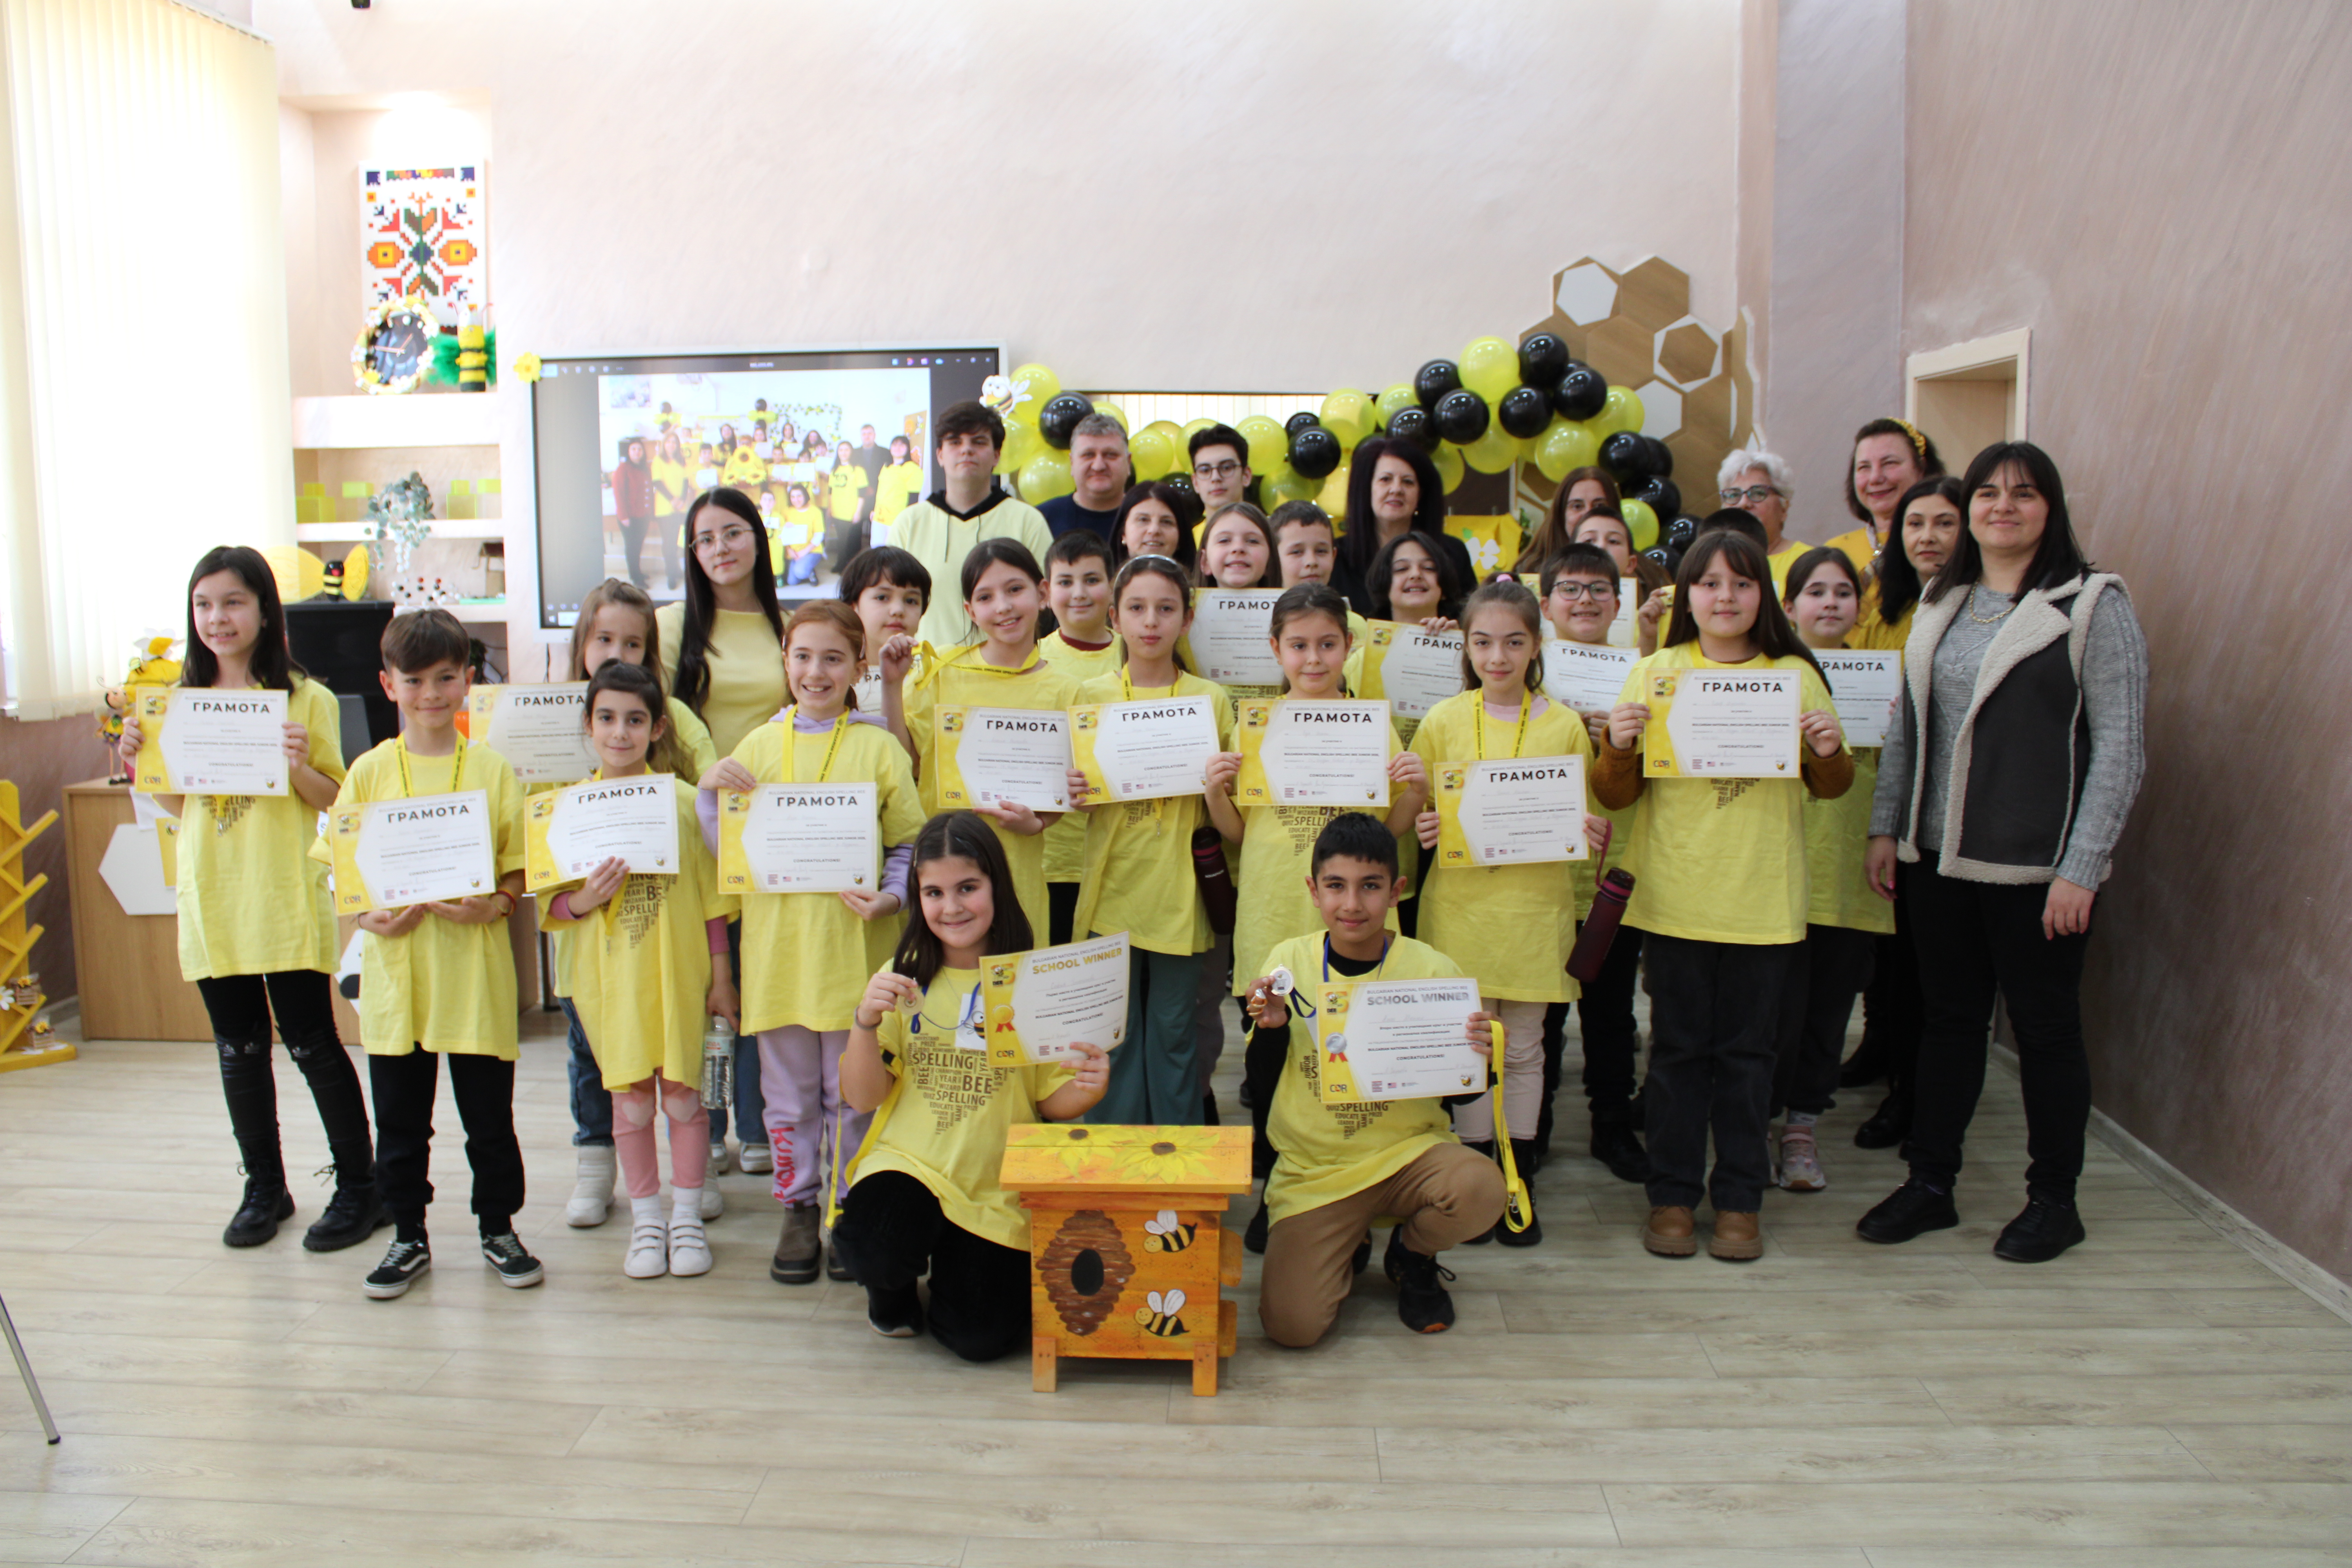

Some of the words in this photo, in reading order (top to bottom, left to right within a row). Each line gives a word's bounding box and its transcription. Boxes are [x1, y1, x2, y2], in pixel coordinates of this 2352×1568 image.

[1562, 648, 1627, 663] ГРАМОТА
[1819, 662, 1885, 671] РАМОТА
[1702, 682, 1783, 692] ГРАМОТА
[515, 695, 585, 706] ГРАМОТА
[193, 702, 270, 713] ГРАМОТА
[1122, 707, 1197, 722] ГРАМОТА
[1294, 713, 1372, 722] ГРАМОТА
[987, 720, 1058, 733] ГРАМОТА
[1490, 769, 1567, 782] ГРАМОТА
[578, 786, 657, 804] ГРАМОТА
[777, 796, 858, 806] ГРАМОТА
[388, 805, 469, 823] ГРАМОТА
[1033, 959, 1080, 974] SCHOOL
[1083, 947, 1122, 965] WINNER
[1367, 995, 1417, 1006] SCHOOL
[1422, 992, 1469, 1003] WINNER
[1062, 1013, 1103, 1025] CONGRATULATIONS!
[913, 1053, 973, 1069] SPELLING
[917, 1067, 929, 1085] BEE
[940, 1075, 957, 1083] YEAR
[962, 1075, 993, 1094] BEE
[936, 1090, 986, 1106] SPELLING
[930, 1102, 954, 1111] EDUCATE
[1340, 1102, 1388, 1112] SPELLING
